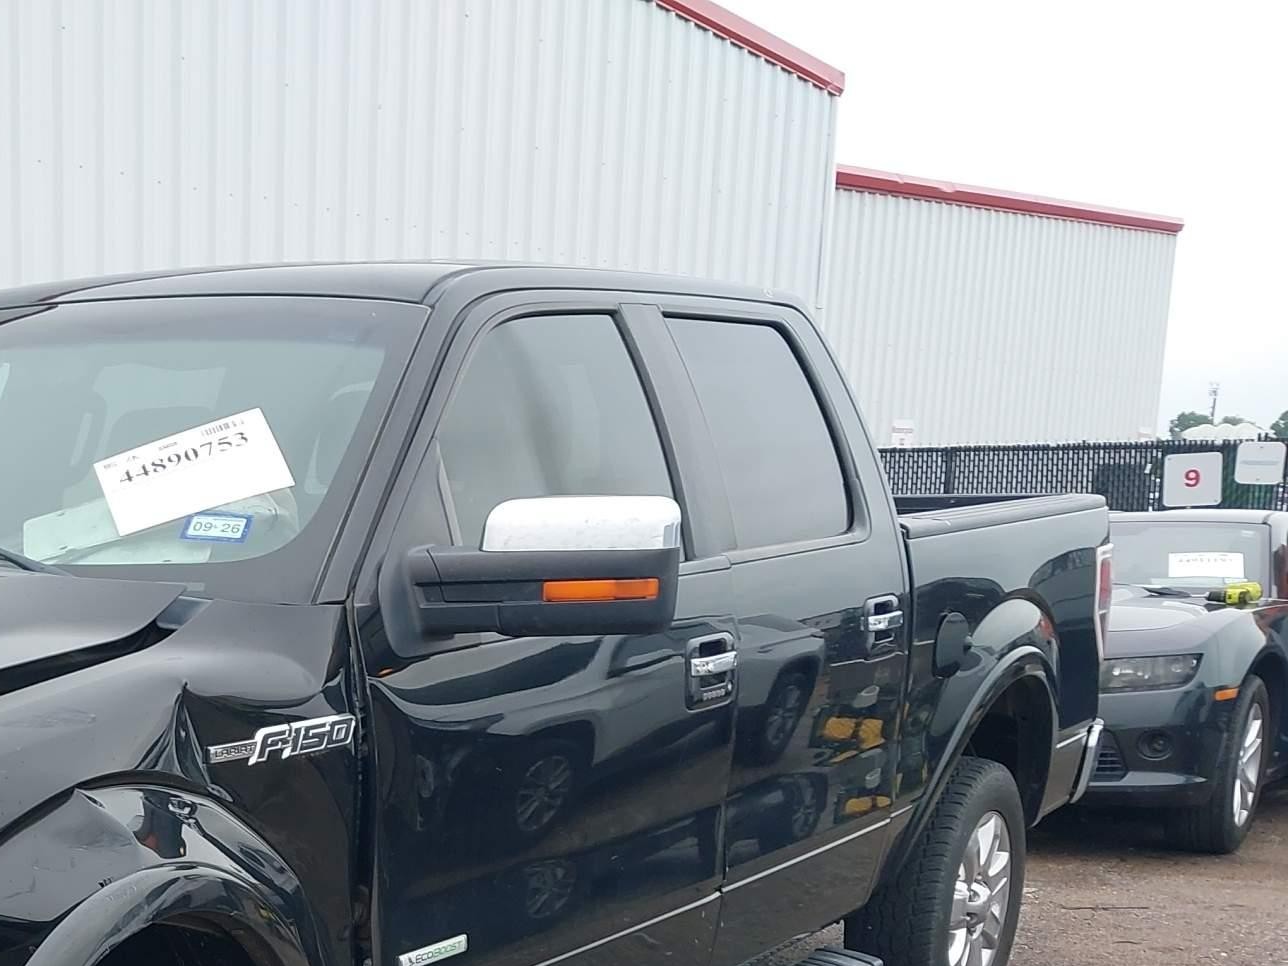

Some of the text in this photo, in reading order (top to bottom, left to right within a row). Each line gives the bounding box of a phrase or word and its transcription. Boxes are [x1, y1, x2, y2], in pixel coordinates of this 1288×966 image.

[120, 432, 248, 482] 44890753
[1184, 469, 1200, 488] 9
[193, 521, 241, 534] 09 26
[249, 713, 356, 766] F-150
